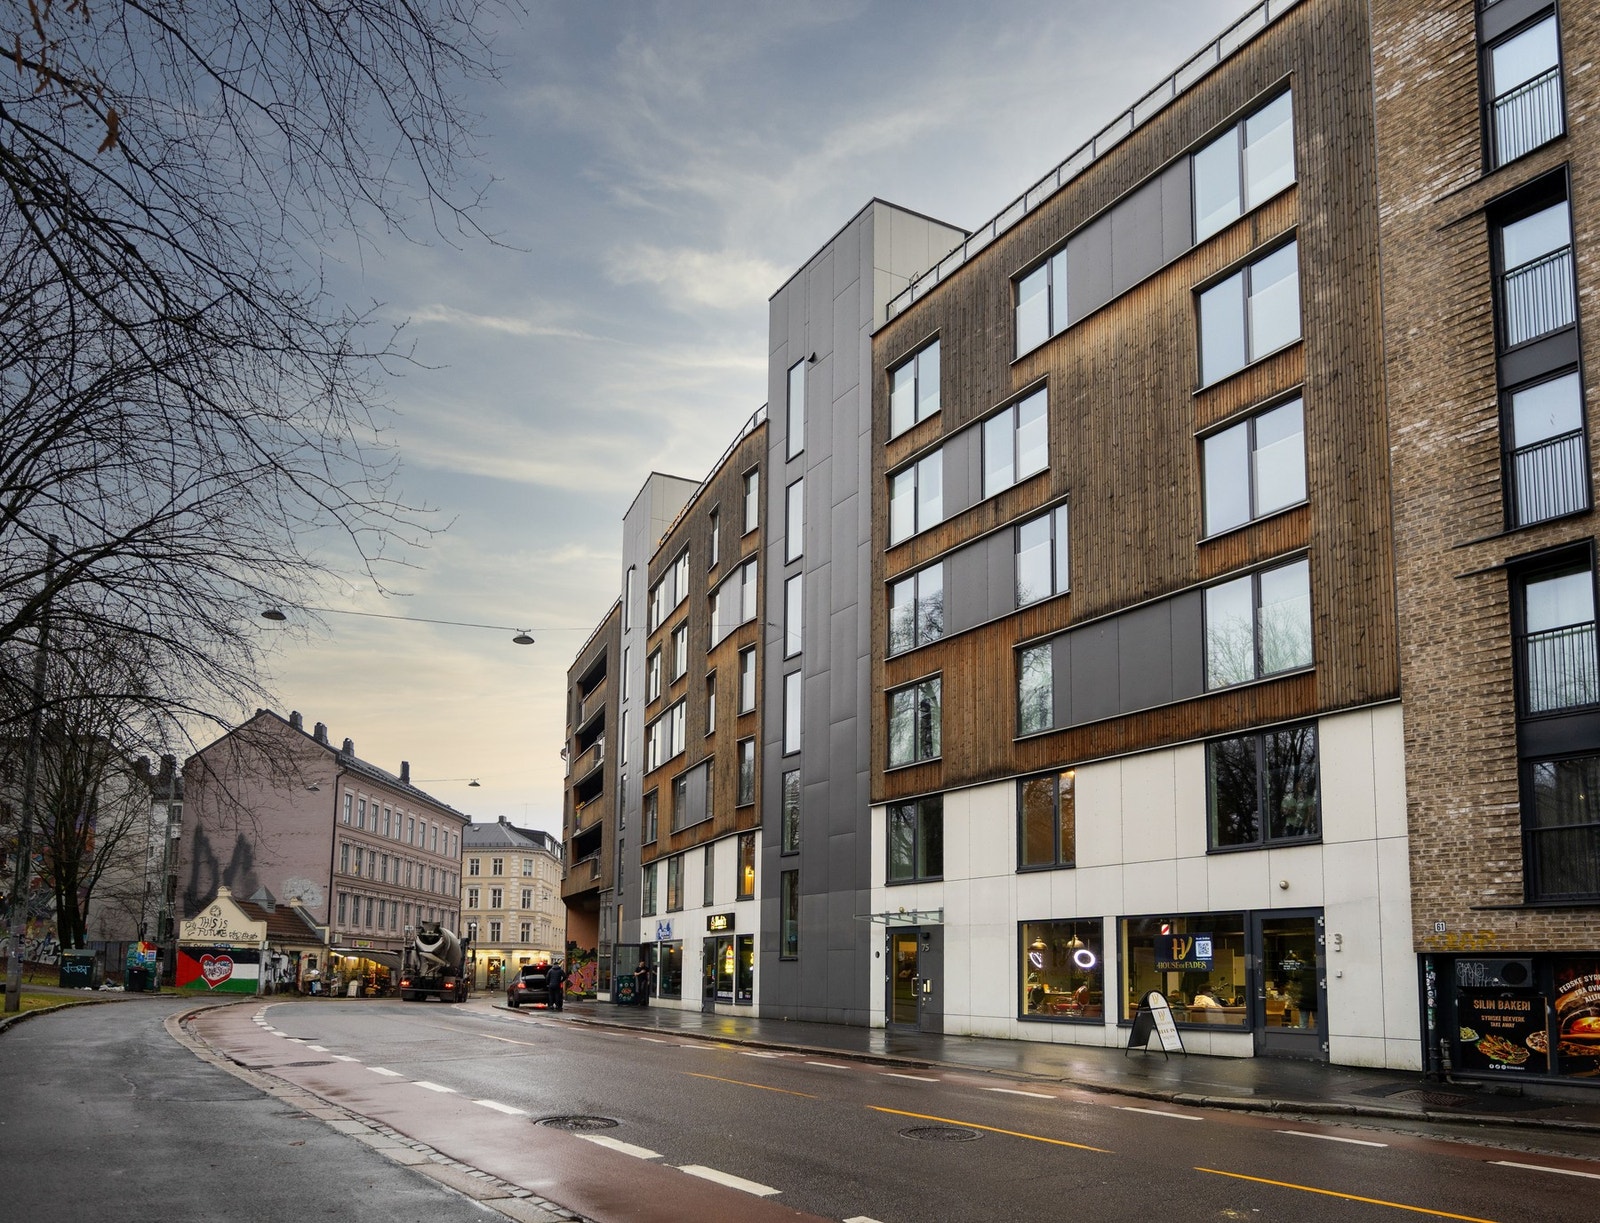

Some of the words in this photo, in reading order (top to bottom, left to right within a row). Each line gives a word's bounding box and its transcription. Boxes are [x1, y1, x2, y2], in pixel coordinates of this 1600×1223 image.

[199, 916, 218, 929] THIS
[1436, 923, 1444, 931] 61
[921, 943, 930, 952] 75
[1157, 961, 1179, 969] HOUSE
[1185, 961, 1207, 970] FADES
[1559, 976, 1583, 994] FERSKE
[1473, 1000, 1496, 1010] SILIN
[1497, 1000, 1531, 1011] BAKERI
